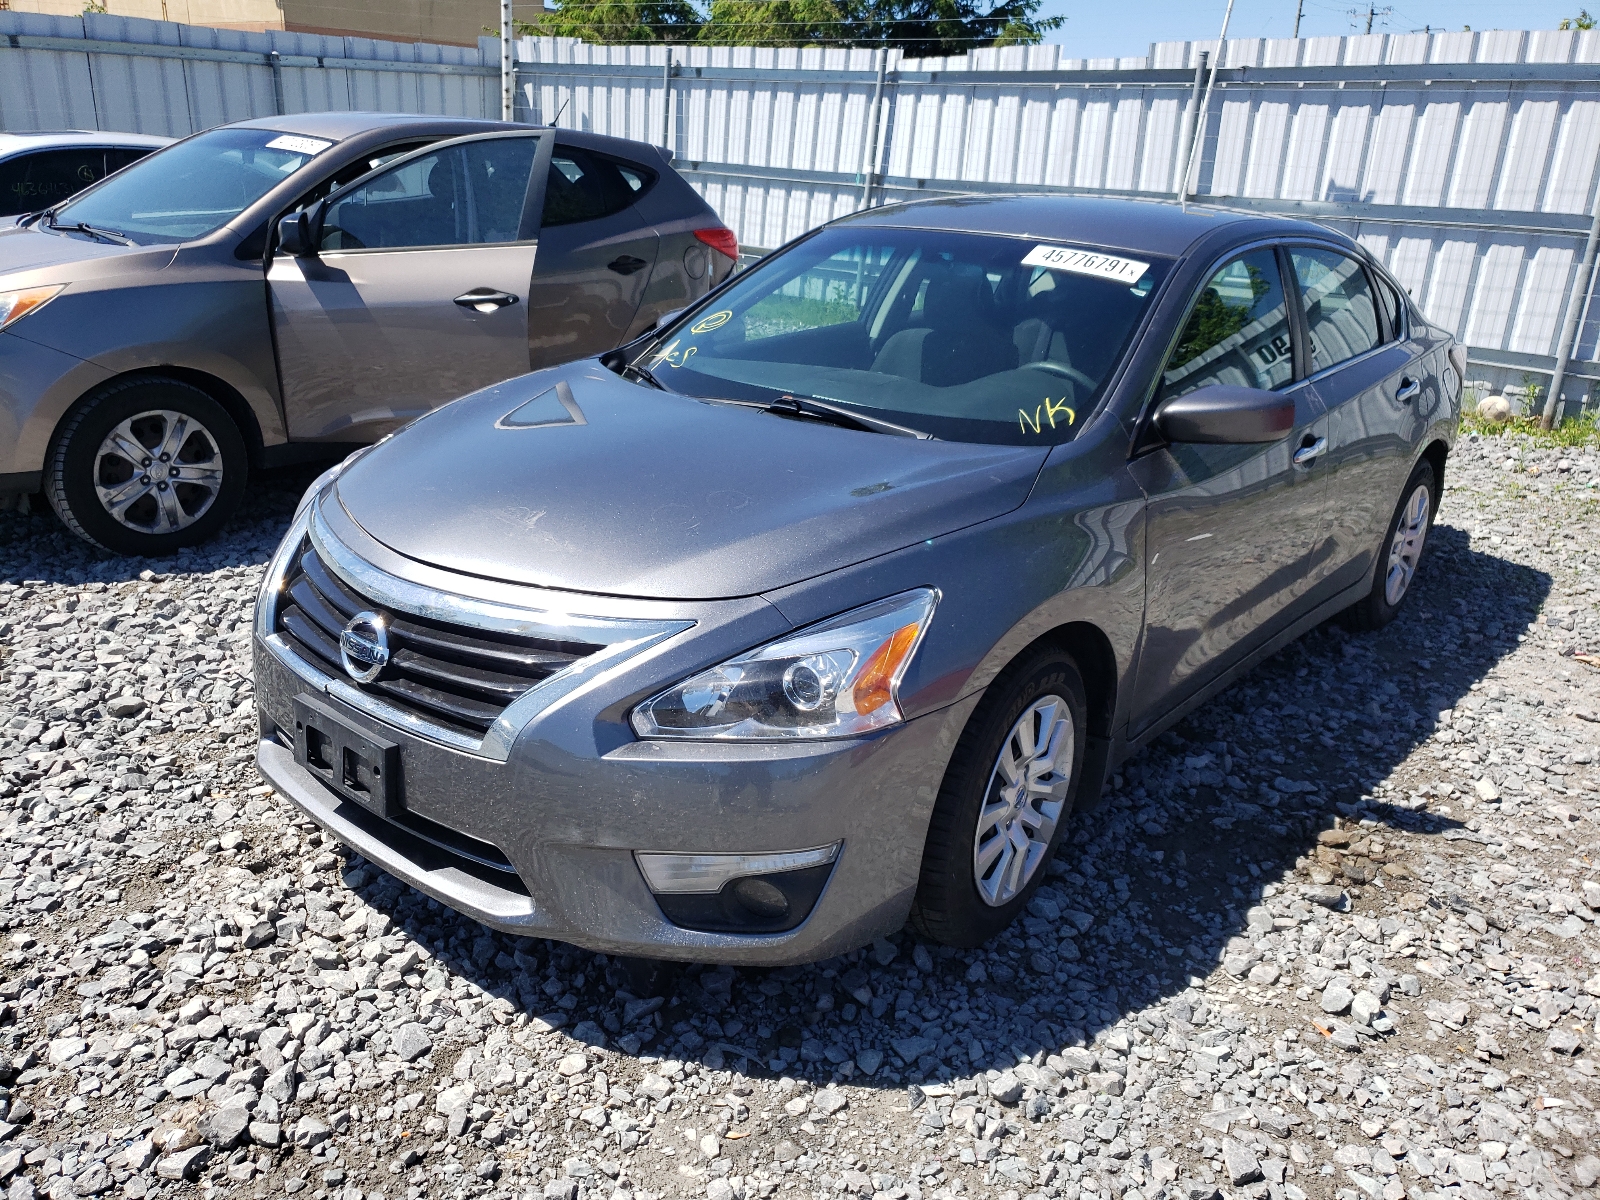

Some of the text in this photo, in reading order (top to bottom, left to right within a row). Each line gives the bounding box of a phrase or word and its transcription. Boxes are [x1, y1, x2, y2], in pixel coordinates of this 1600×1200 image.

[1042, 249, 1130, 275] 45776791
[1019, 396, 1075, 434] NK
[340, 632, 380, 662] NISSAN
